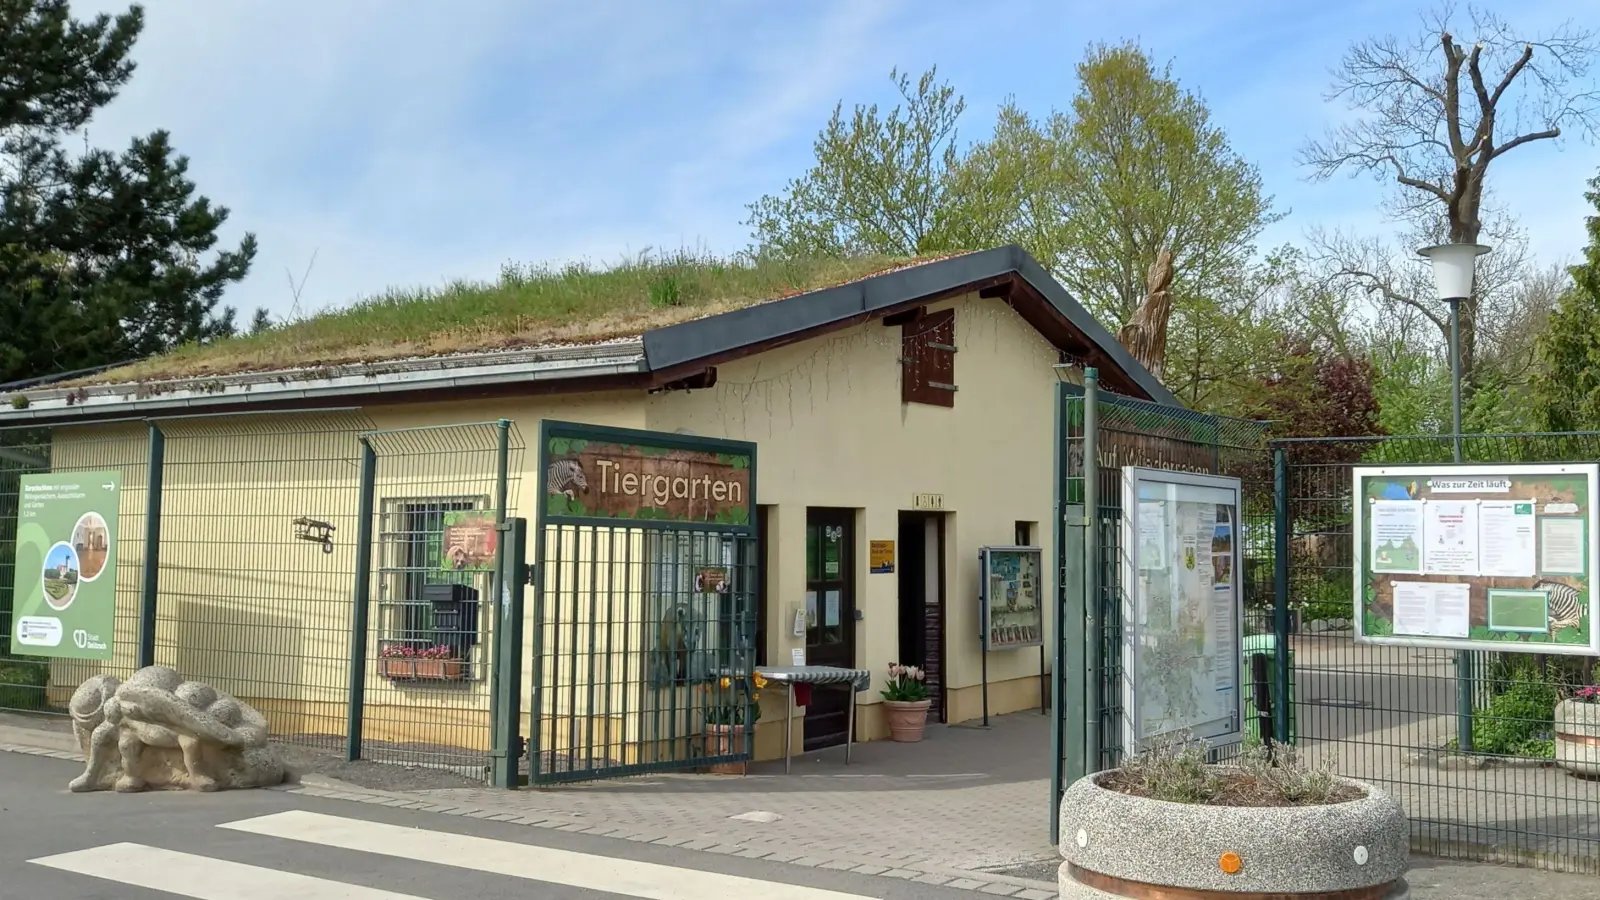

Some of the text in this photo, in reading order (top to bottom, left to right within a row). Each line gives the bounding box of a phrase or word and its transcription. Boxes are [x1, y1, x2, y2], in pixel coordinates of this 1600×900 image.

[1096, 443, 1117, 468] Auf
[597, 460, 741, 505] Tiergarten
[1468, 480, 1484, 488] Zeit
